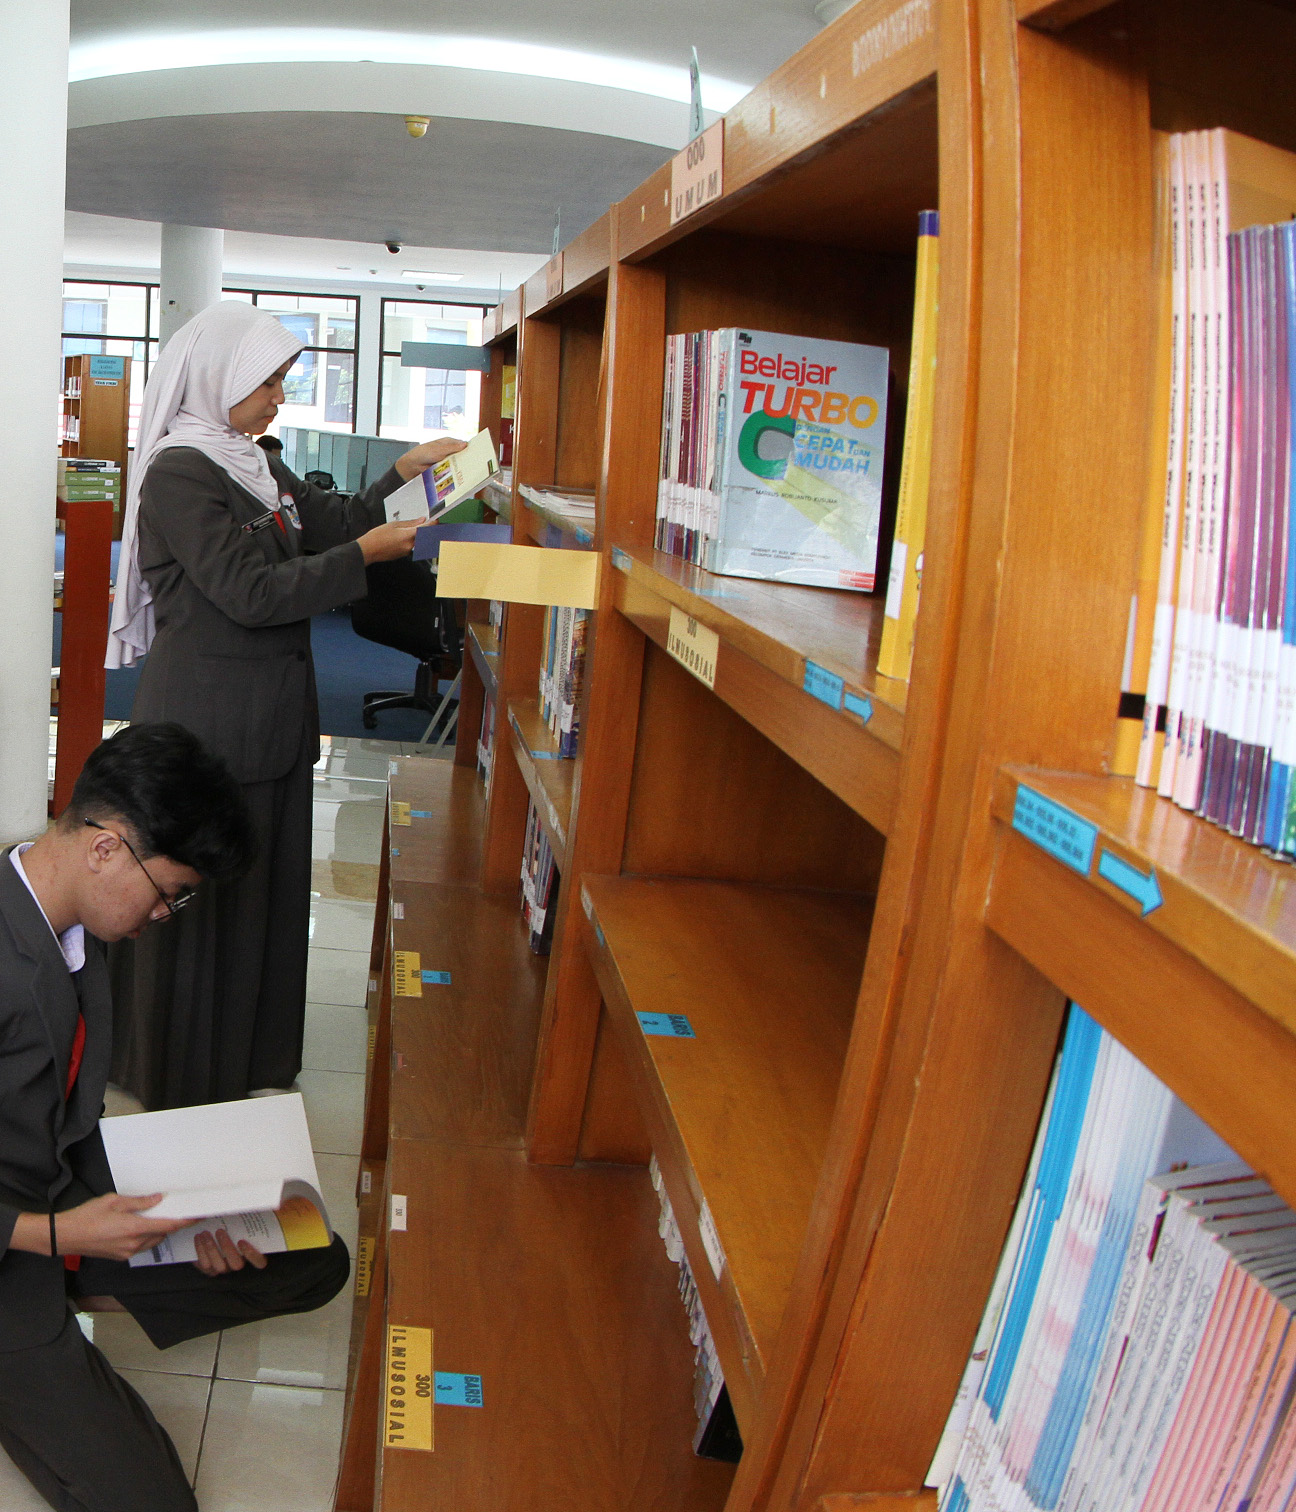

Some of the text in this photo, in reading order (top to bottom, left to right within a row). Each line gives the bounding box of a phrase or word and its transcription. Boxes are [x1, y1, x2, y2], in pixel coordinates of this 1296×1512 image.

[675, 169, 718, 219] UMUM
[740, 349, 838, 387] Belajar
[740, 380, 880, 429] TURBO
[738, 408, 796, 480] C
[794, 434, 859, 455] CEPAT
[794, 451, 871, 475] MUDAH
[389, 1328, 406, 1443] ILMUSOSIAL
[415, 1374, 430, 1398] 300
[464, 1376, 481, 1404] BARIS
